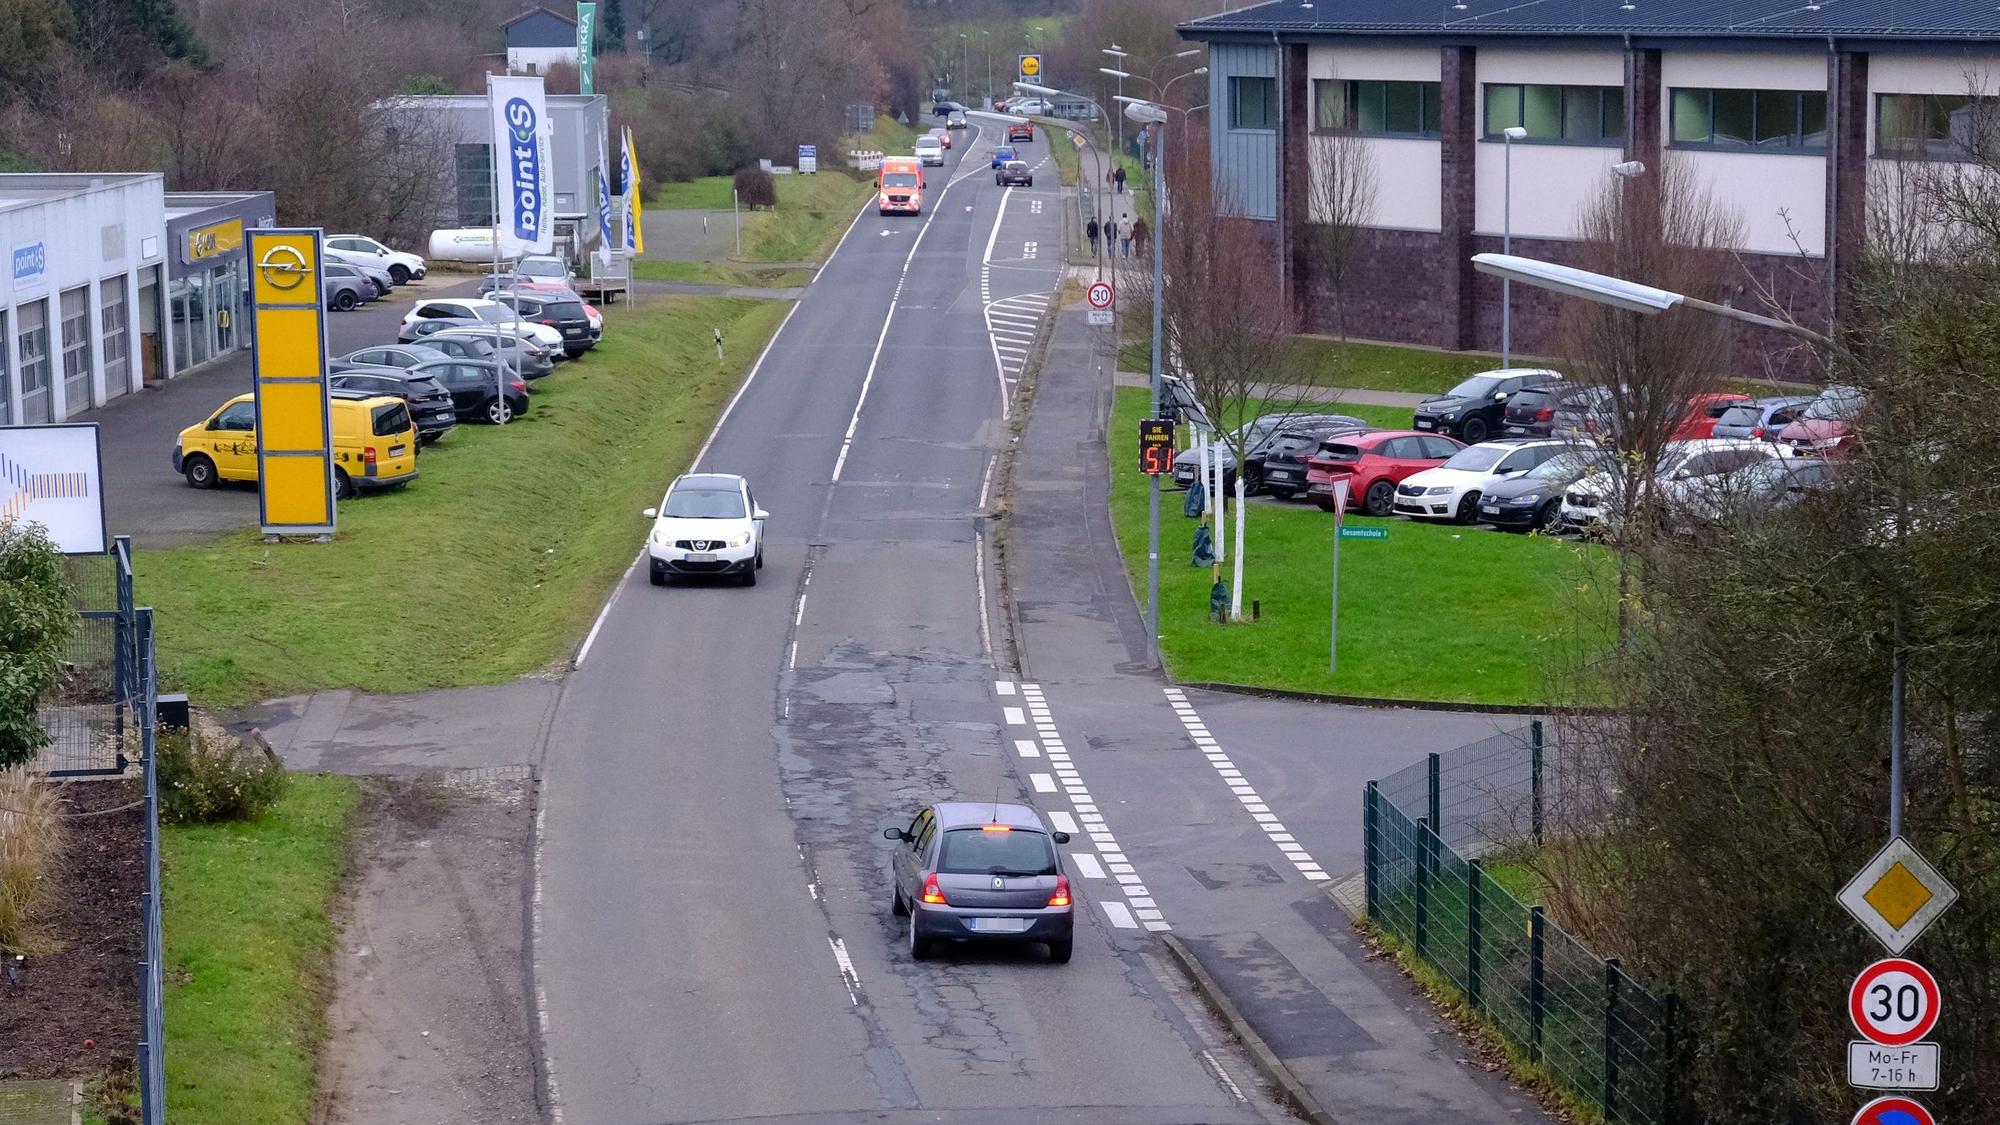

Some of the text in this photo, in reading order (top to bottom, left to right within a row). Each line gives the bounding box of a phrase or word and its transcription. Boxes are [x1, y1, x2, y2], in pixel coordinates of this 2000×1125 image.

[580, 12, 591, 65] DEKRA
[515, 146, 536, 232] point
[15, 250, 36, 275] point
[1092, 289, 1109, 302] 30
[1144, 433, 1170, 442] FAHREN
[1151, 426, 1163, 434] SIE
[1146, 446, 1172, 473] 51
[1870, 984, 1920, 1022] 30
[1869, 1050, 1919, 1065] Mo-Fr
[1871, 1068, 1916, 1083] 7-16 h
